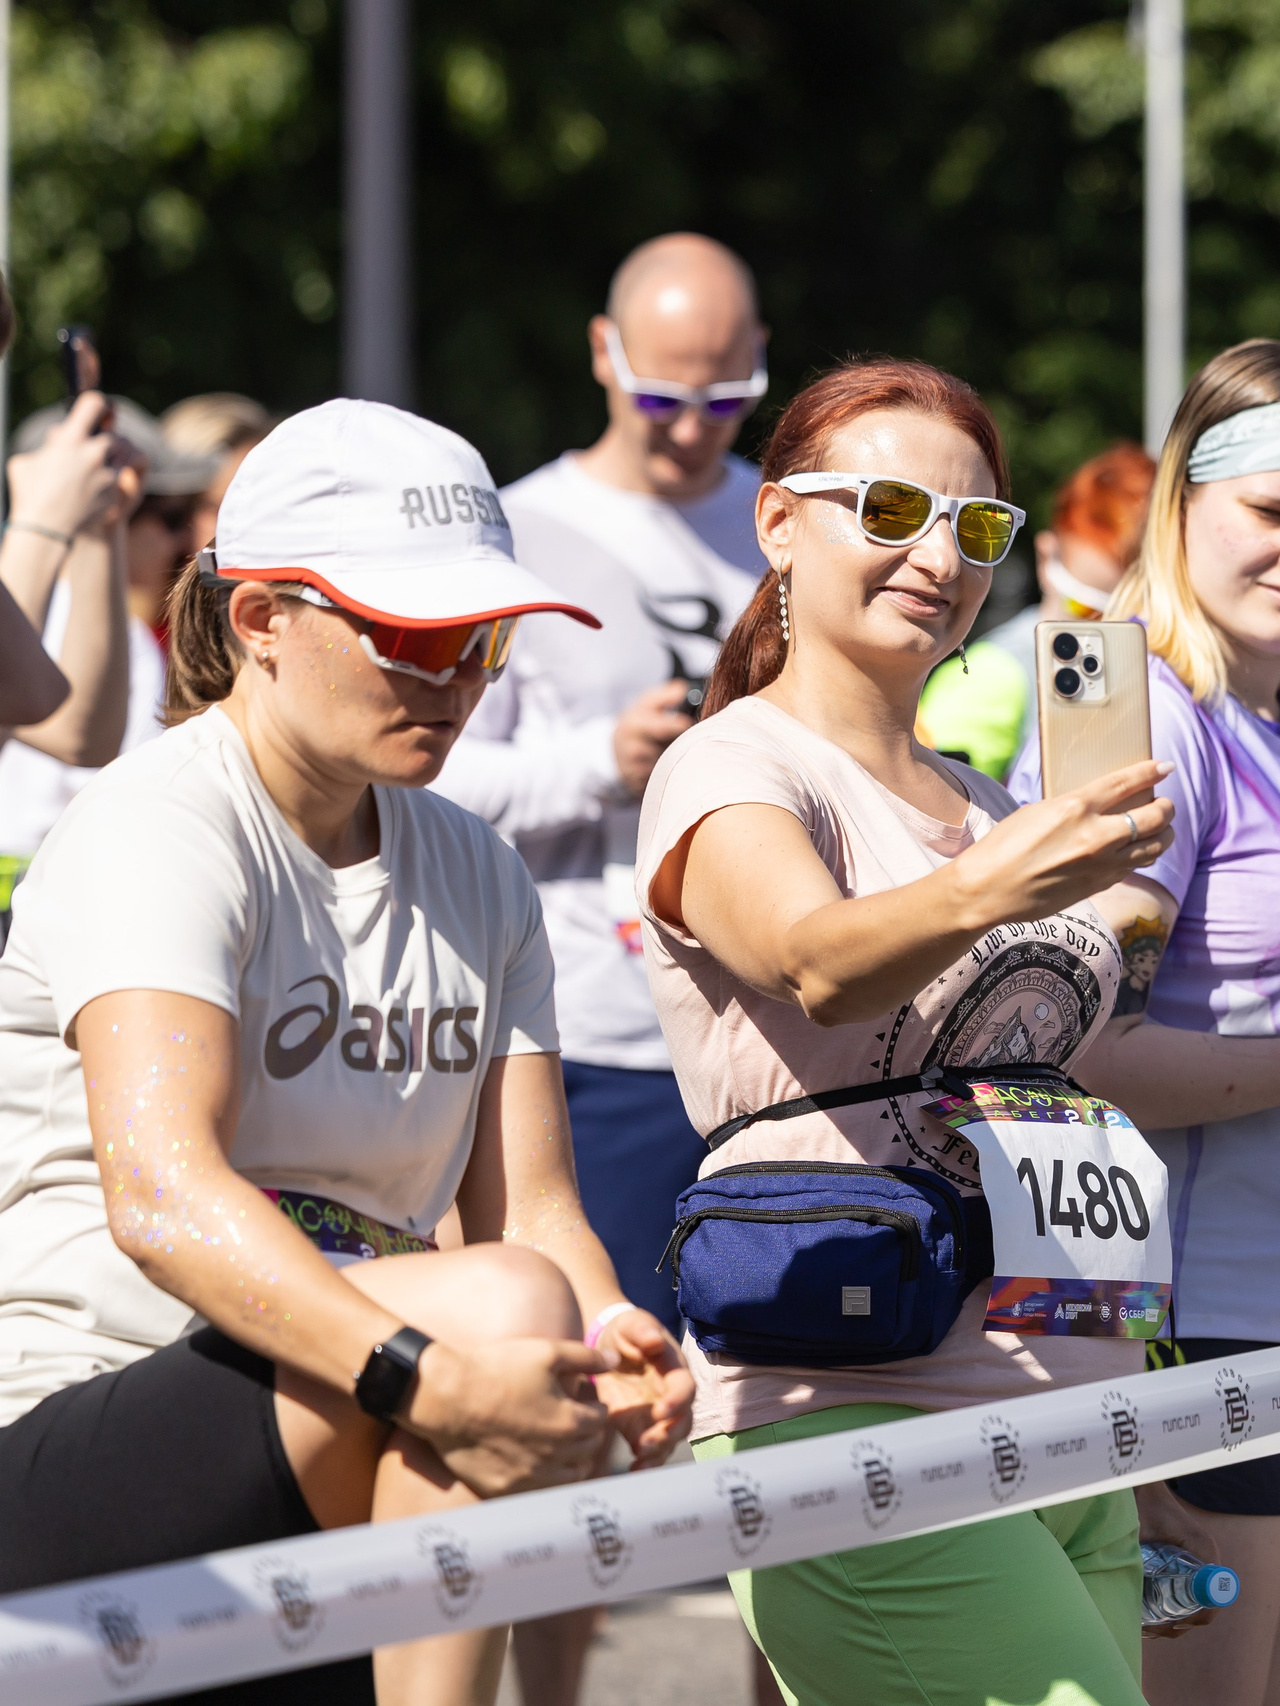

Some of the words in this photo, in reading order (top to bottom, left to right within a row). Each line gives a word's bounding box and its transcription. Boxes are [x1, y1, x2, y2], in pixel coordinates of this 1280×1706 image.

[1030, 920, 1058, 940] the
[1065, 924, 1101, 962] day
[340, 1003, 479, 1074] asics
[1016, 1157, 1150, 1241] 1480
[1128, 1309, 1145, 1319] СБЕР
